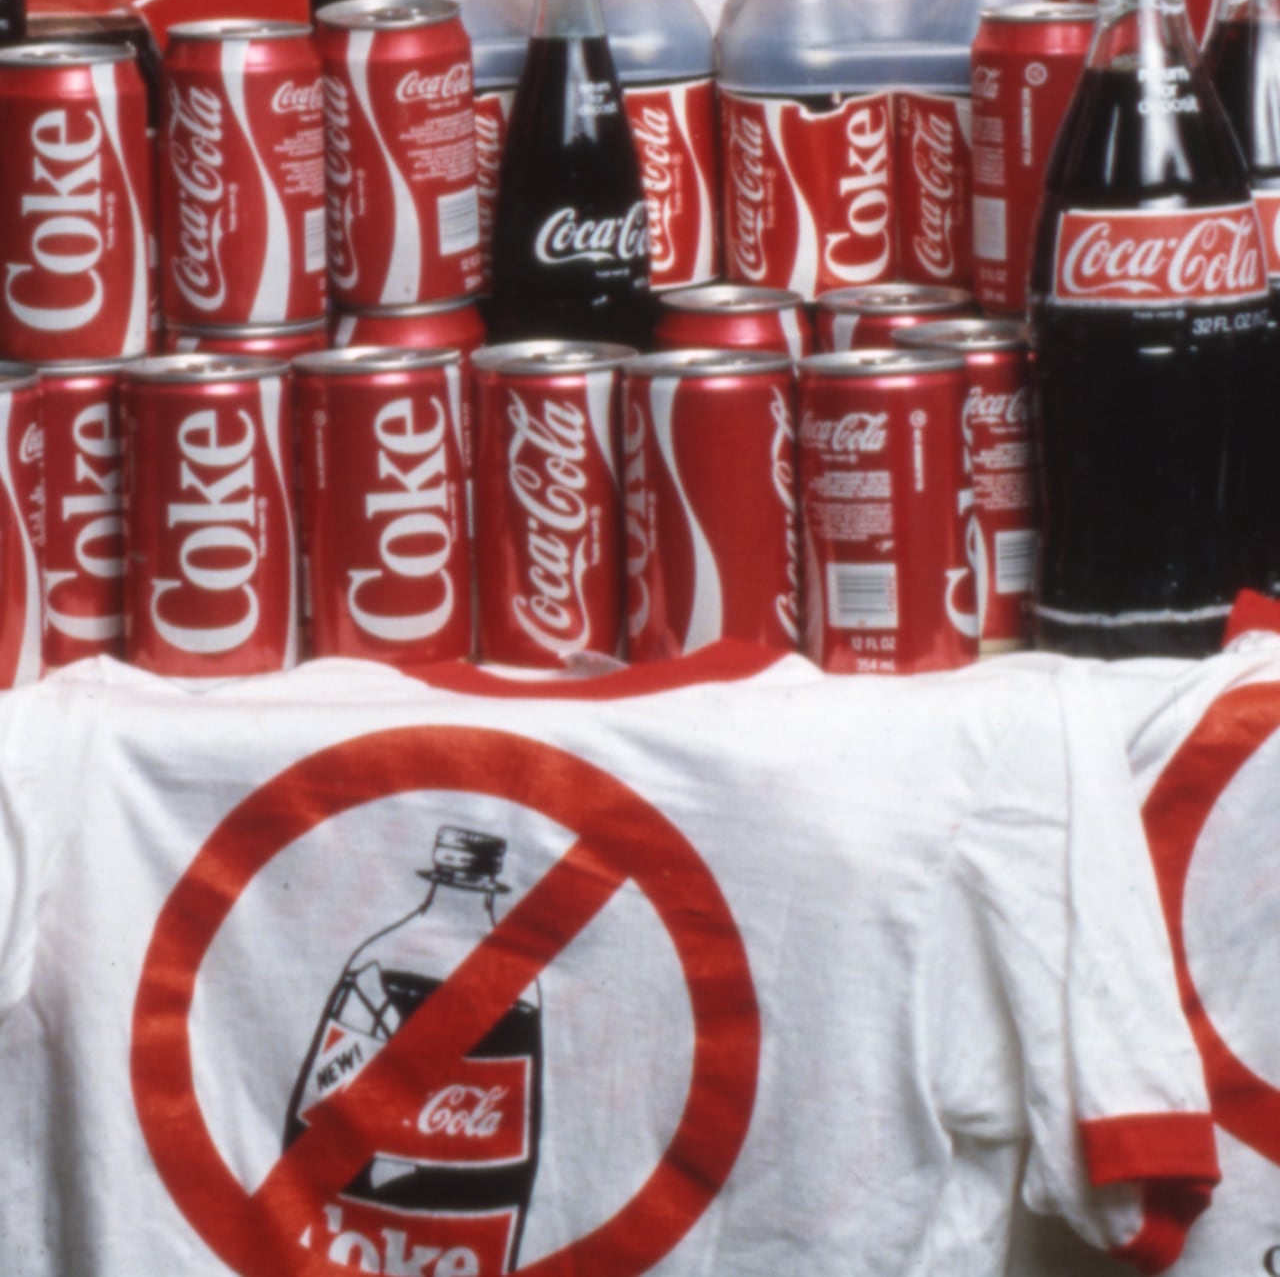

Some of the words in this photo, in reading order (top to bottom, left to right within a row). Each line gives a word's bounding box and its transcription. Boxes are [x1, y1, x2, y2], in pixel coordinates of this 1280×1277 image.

[5, 109, 105, 332] Coke
[825, 107, 891, 284] Coke
[149, 409, 260, 654] Coke
[347, 396, 454, 641] Coke
[418, 1084, 508, 1138] Cola
